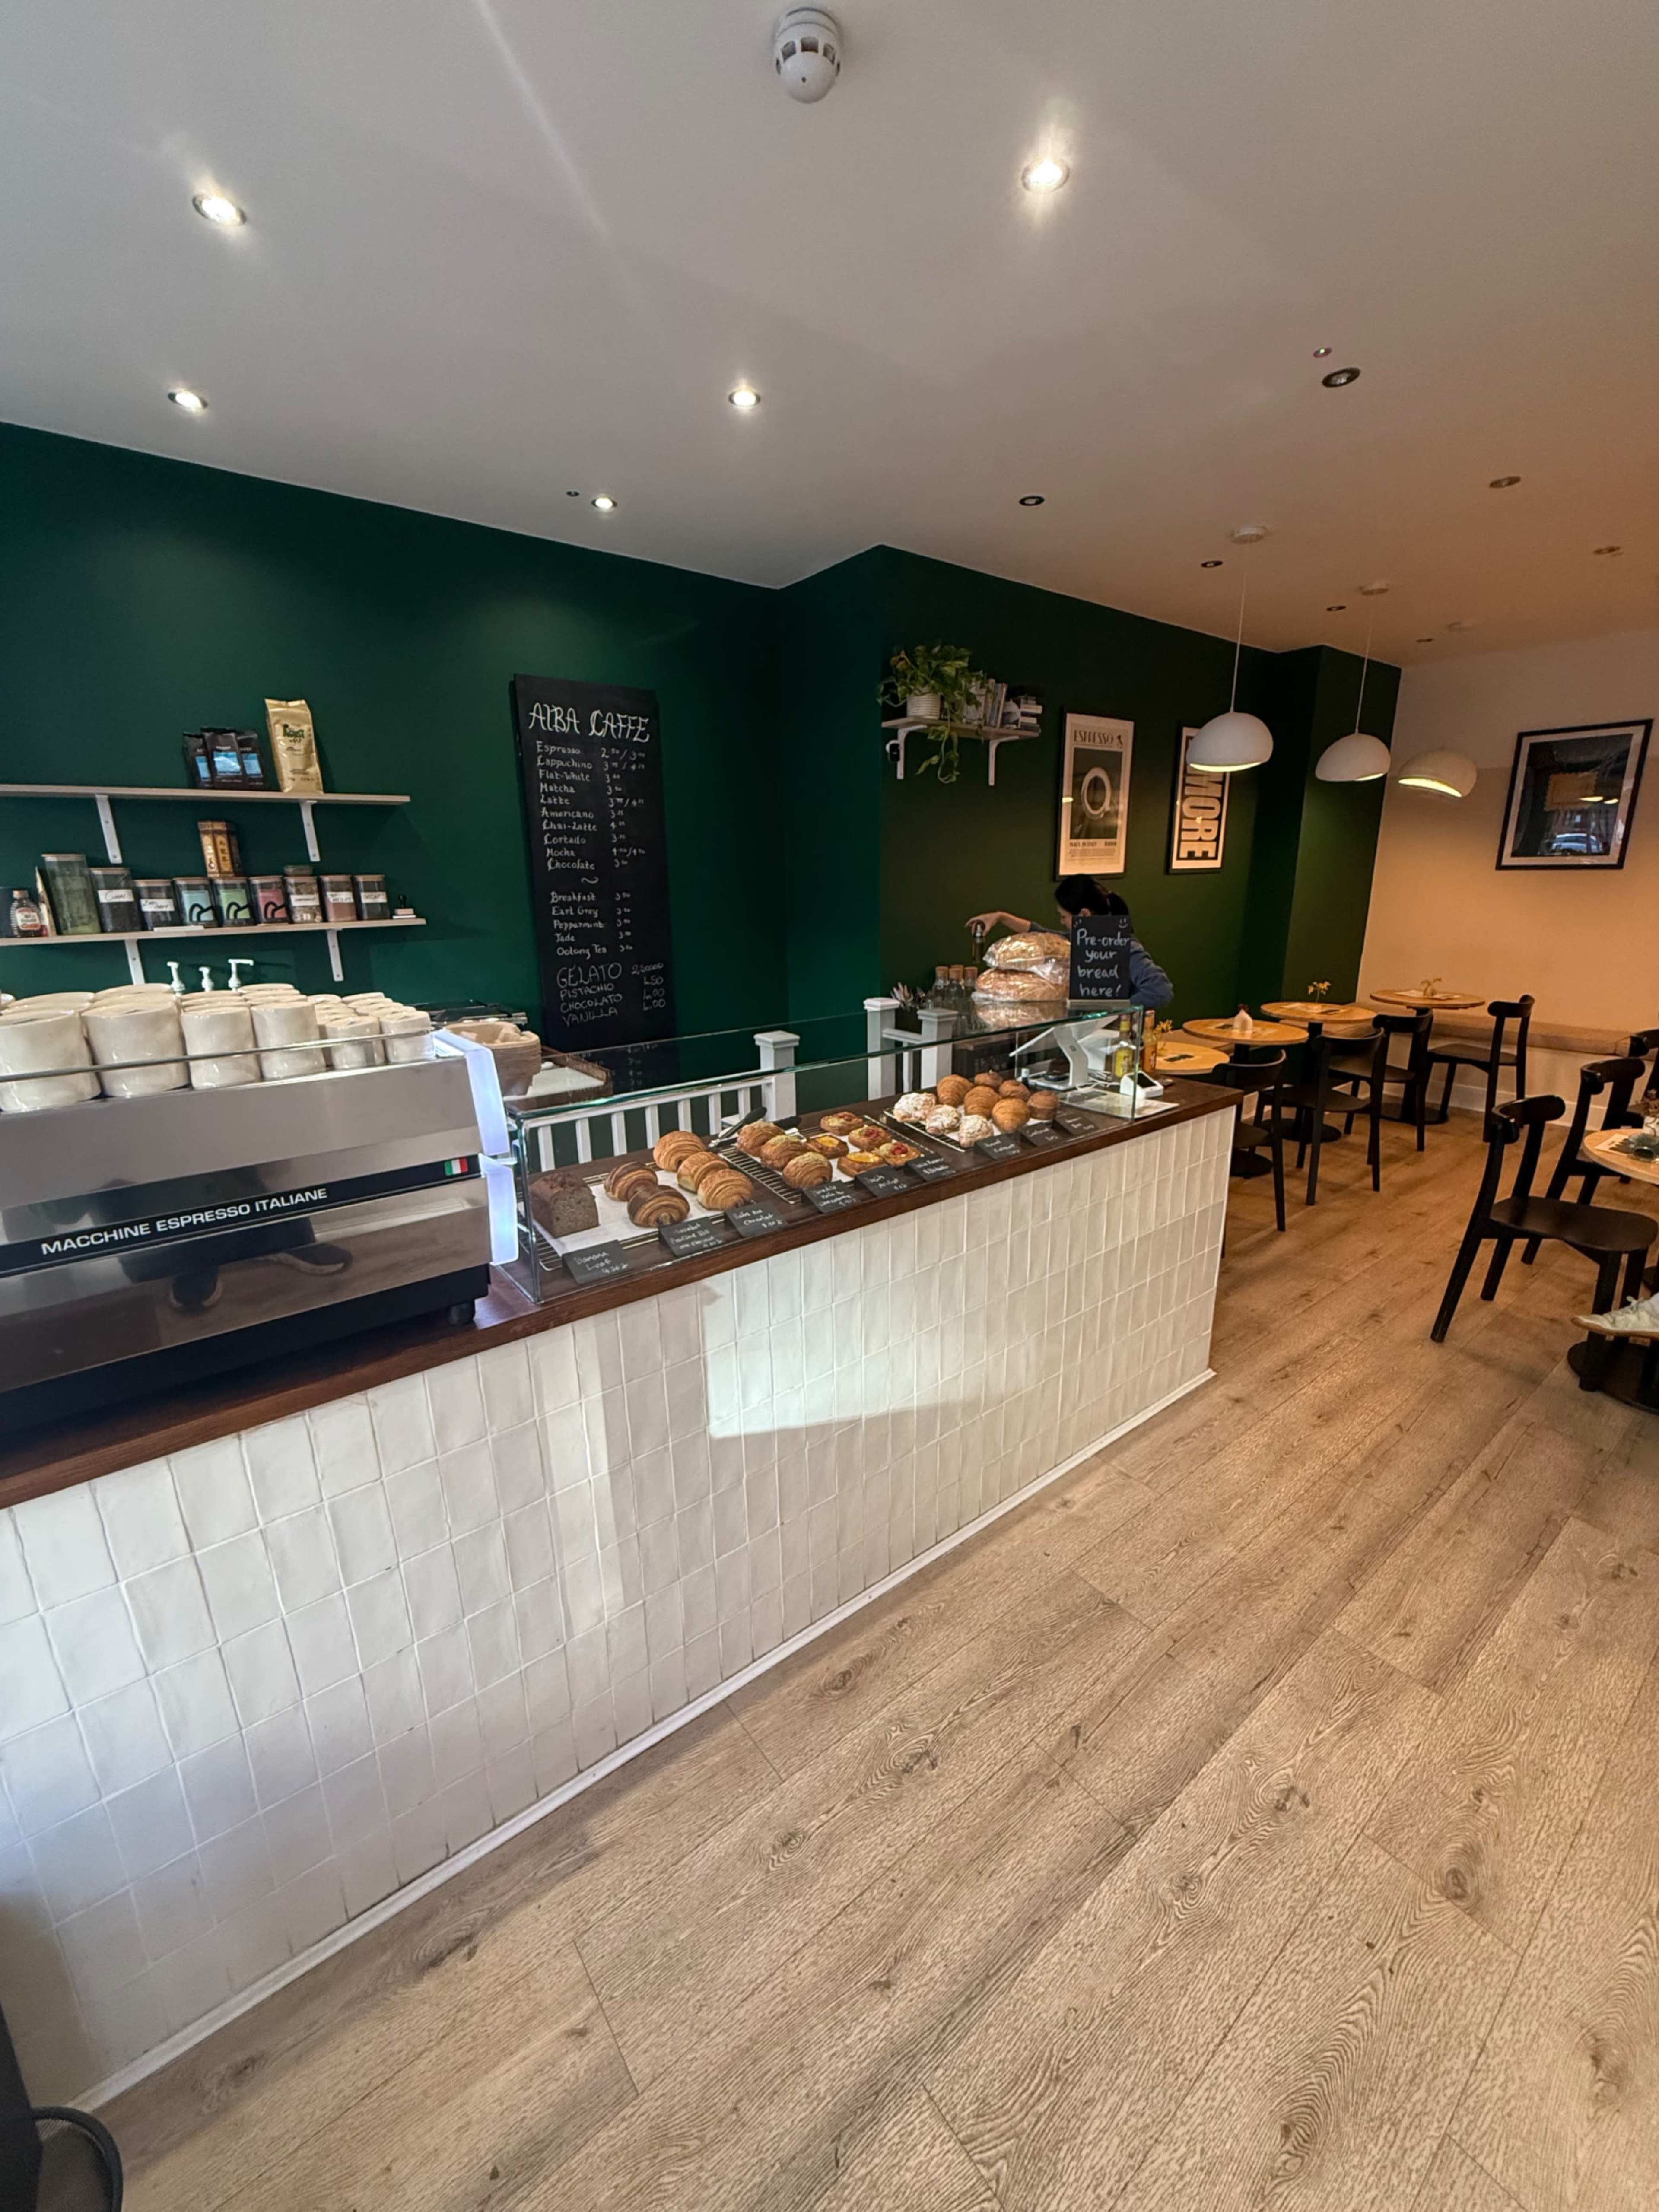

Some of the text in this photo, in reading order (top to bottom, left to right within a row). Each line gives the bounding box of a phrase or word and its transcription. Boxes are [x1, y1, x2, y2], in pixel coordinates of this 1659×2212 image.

[536, 740, 581, 756] Espresso
[536, 755, 593, 770] Cappuchino
[540, 782, 575, 793] Matcha
[540, 795, 569, 804] Latte
[541, 807, 594, 818] Americano
[544, 833, 586, 845] Cortado
[546, 848, 575, 857] Mocha
[547, 858, 594, 871] Chocolate
[550, 891, 595, 903] Breakfast
[552, 906, 574, 915] Earl
[577, 906, 598, 918] Grey
[553, 920, 604, 931] Peppermint
[555, 933, 575, 942] Jade
[1077, 927, 1130, 946] Pre-order
[557, 947, 591, 959] Oolong
[1085, 950, 1116, 963] your
[557, 962, 622, 988] GELATO
[1077, 965, 1118, 979] bread
[560, 983, 614, 999] PISTACHIO
[1080, 984, 1121, 997] here!
[560, 993, 623, 1013] CHOCOLATO
[563, 1007, 618, 1027] VANILLA
[41, 1188, 327, 1255] MACCHINE ESPRESSO ITALIANE
